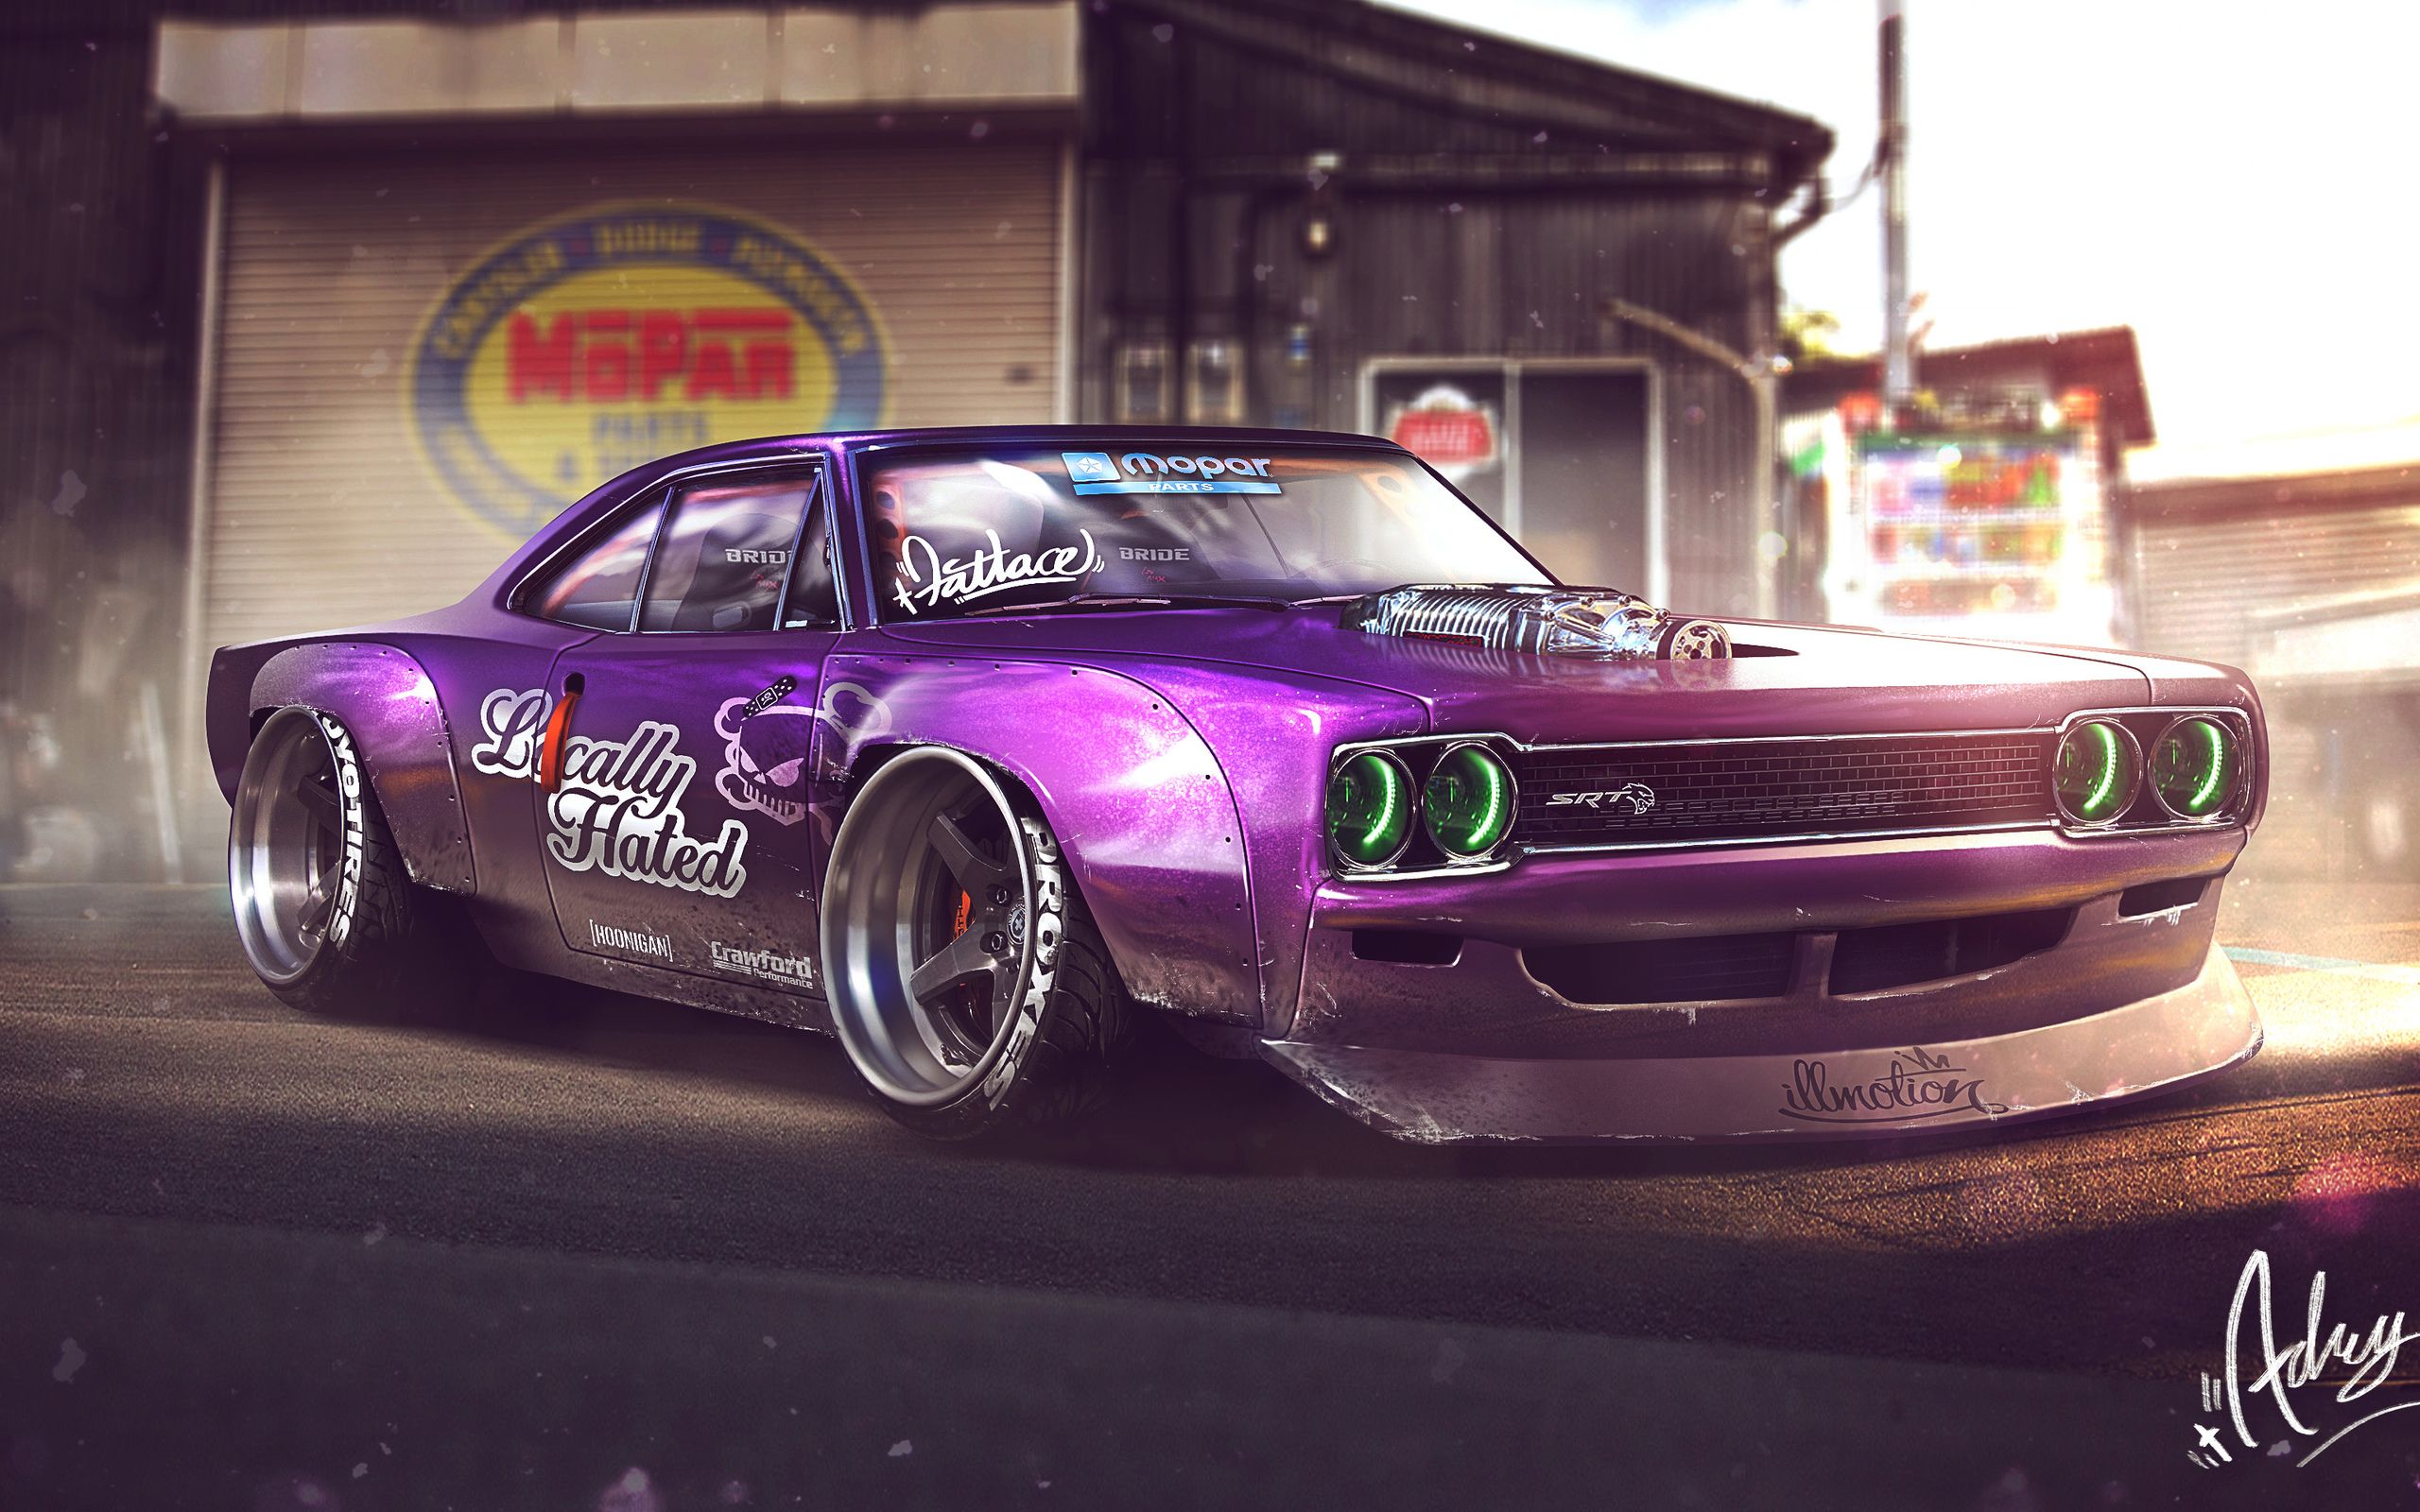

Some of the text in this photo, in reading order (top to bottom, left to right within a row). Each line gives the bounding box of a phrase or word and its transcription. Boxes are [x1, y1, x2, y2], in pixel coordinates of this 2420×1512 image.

[1149, 482, 1215, 492] PARTS
[1118, 547, 1190, 561] BRIDE
[1545, 791, 1633, 809] SRT
[551, 786, 744, 896] Hated
[330, 801, 363, 953] TIRES
[711, 940, 813, 979] Crawford
[753, 967, 814, 989] Performance
[983, 816, 1063, 1112] PROXES
[1781, 1058, 2009, 1114] illmotion
